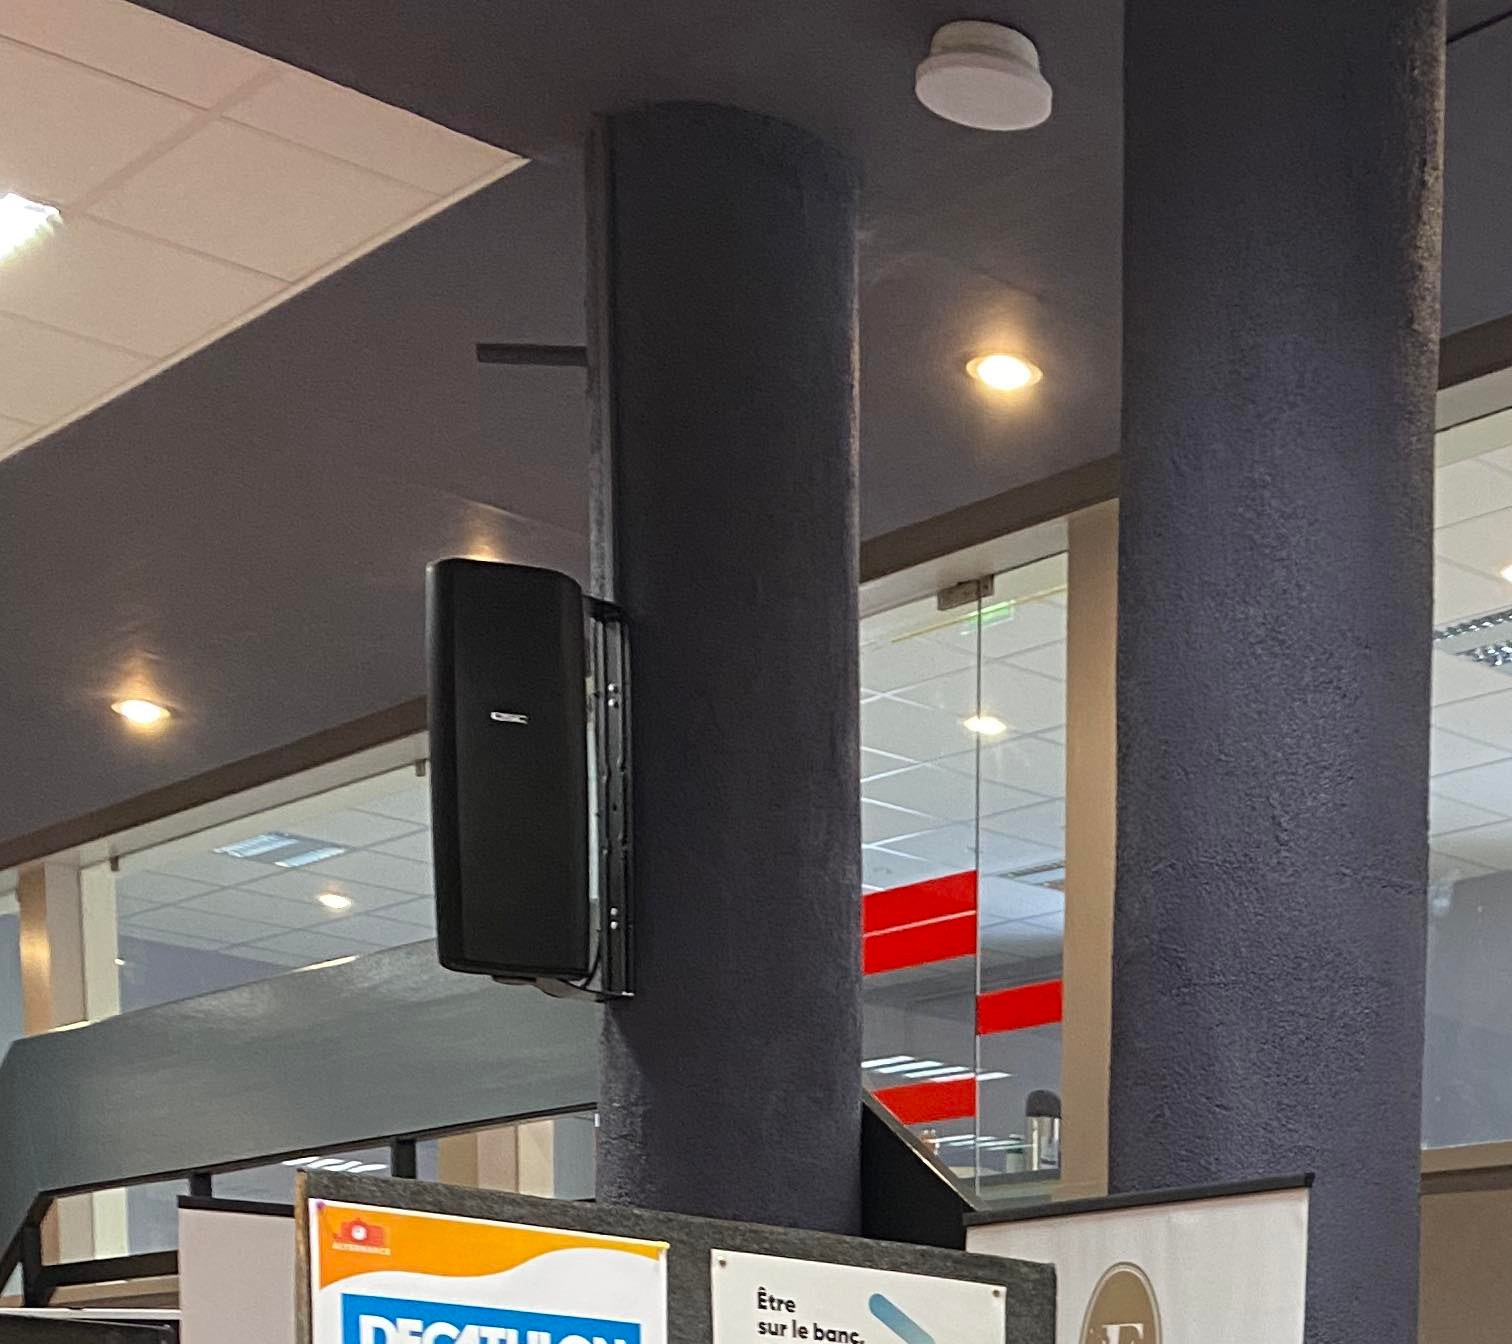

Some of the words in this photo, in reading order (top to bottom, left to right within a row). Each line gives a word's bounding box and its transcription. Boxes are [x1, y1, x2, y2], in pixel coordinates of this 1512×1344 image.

[756, 1287, 796, 1313] Être
[758, 1321, 786, 1337] sur
[791, 1320, 809, 1339] le
